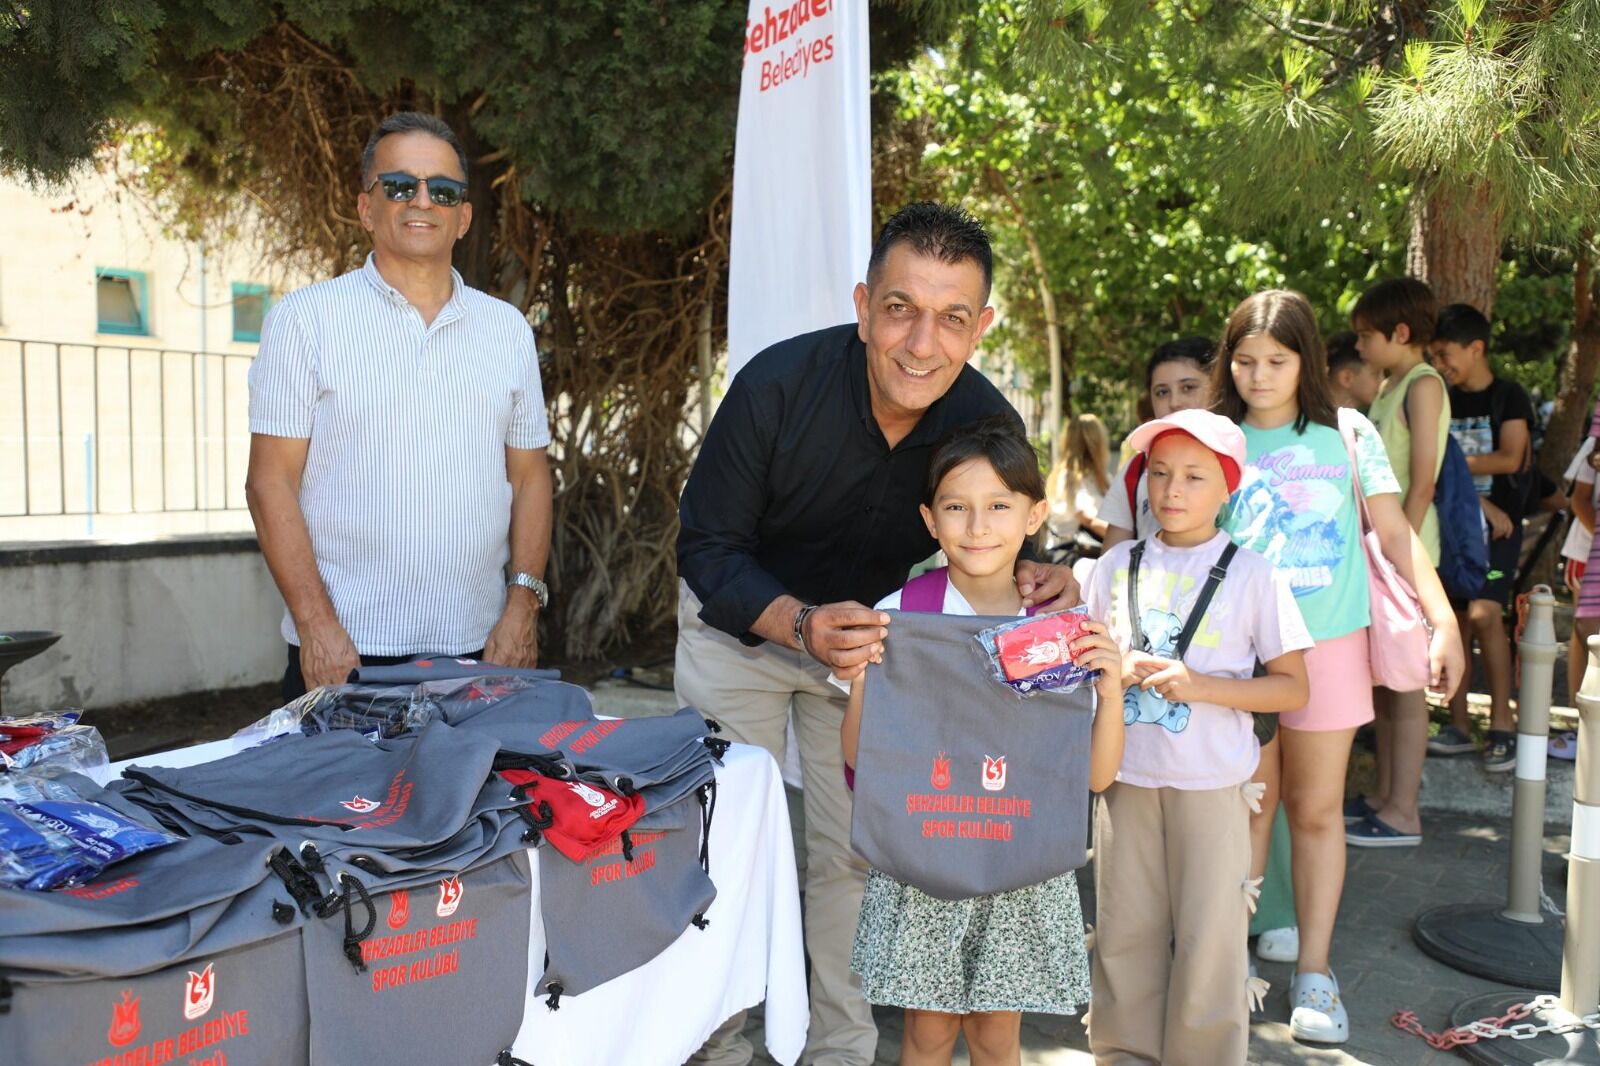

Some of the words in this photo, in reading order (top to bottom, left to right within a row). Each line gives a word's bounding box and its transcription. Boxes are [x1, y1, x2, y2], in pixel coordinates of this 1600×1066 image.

[906, 793, 975, 816] ŞEHZADELER
[977, 796, 1031, 817] BELEDİYE
[921, 819, 956, 838] SPOR
[958, 819, 1013, 841] KULÜBÜ
[429, 917, 479, 948] BELEDİYE
[372, 964, 408, 993] SPOR
[409, 947, 460, 984] KULÜBÜ
[177, 1009, 249, 1057] BELEDİYE
